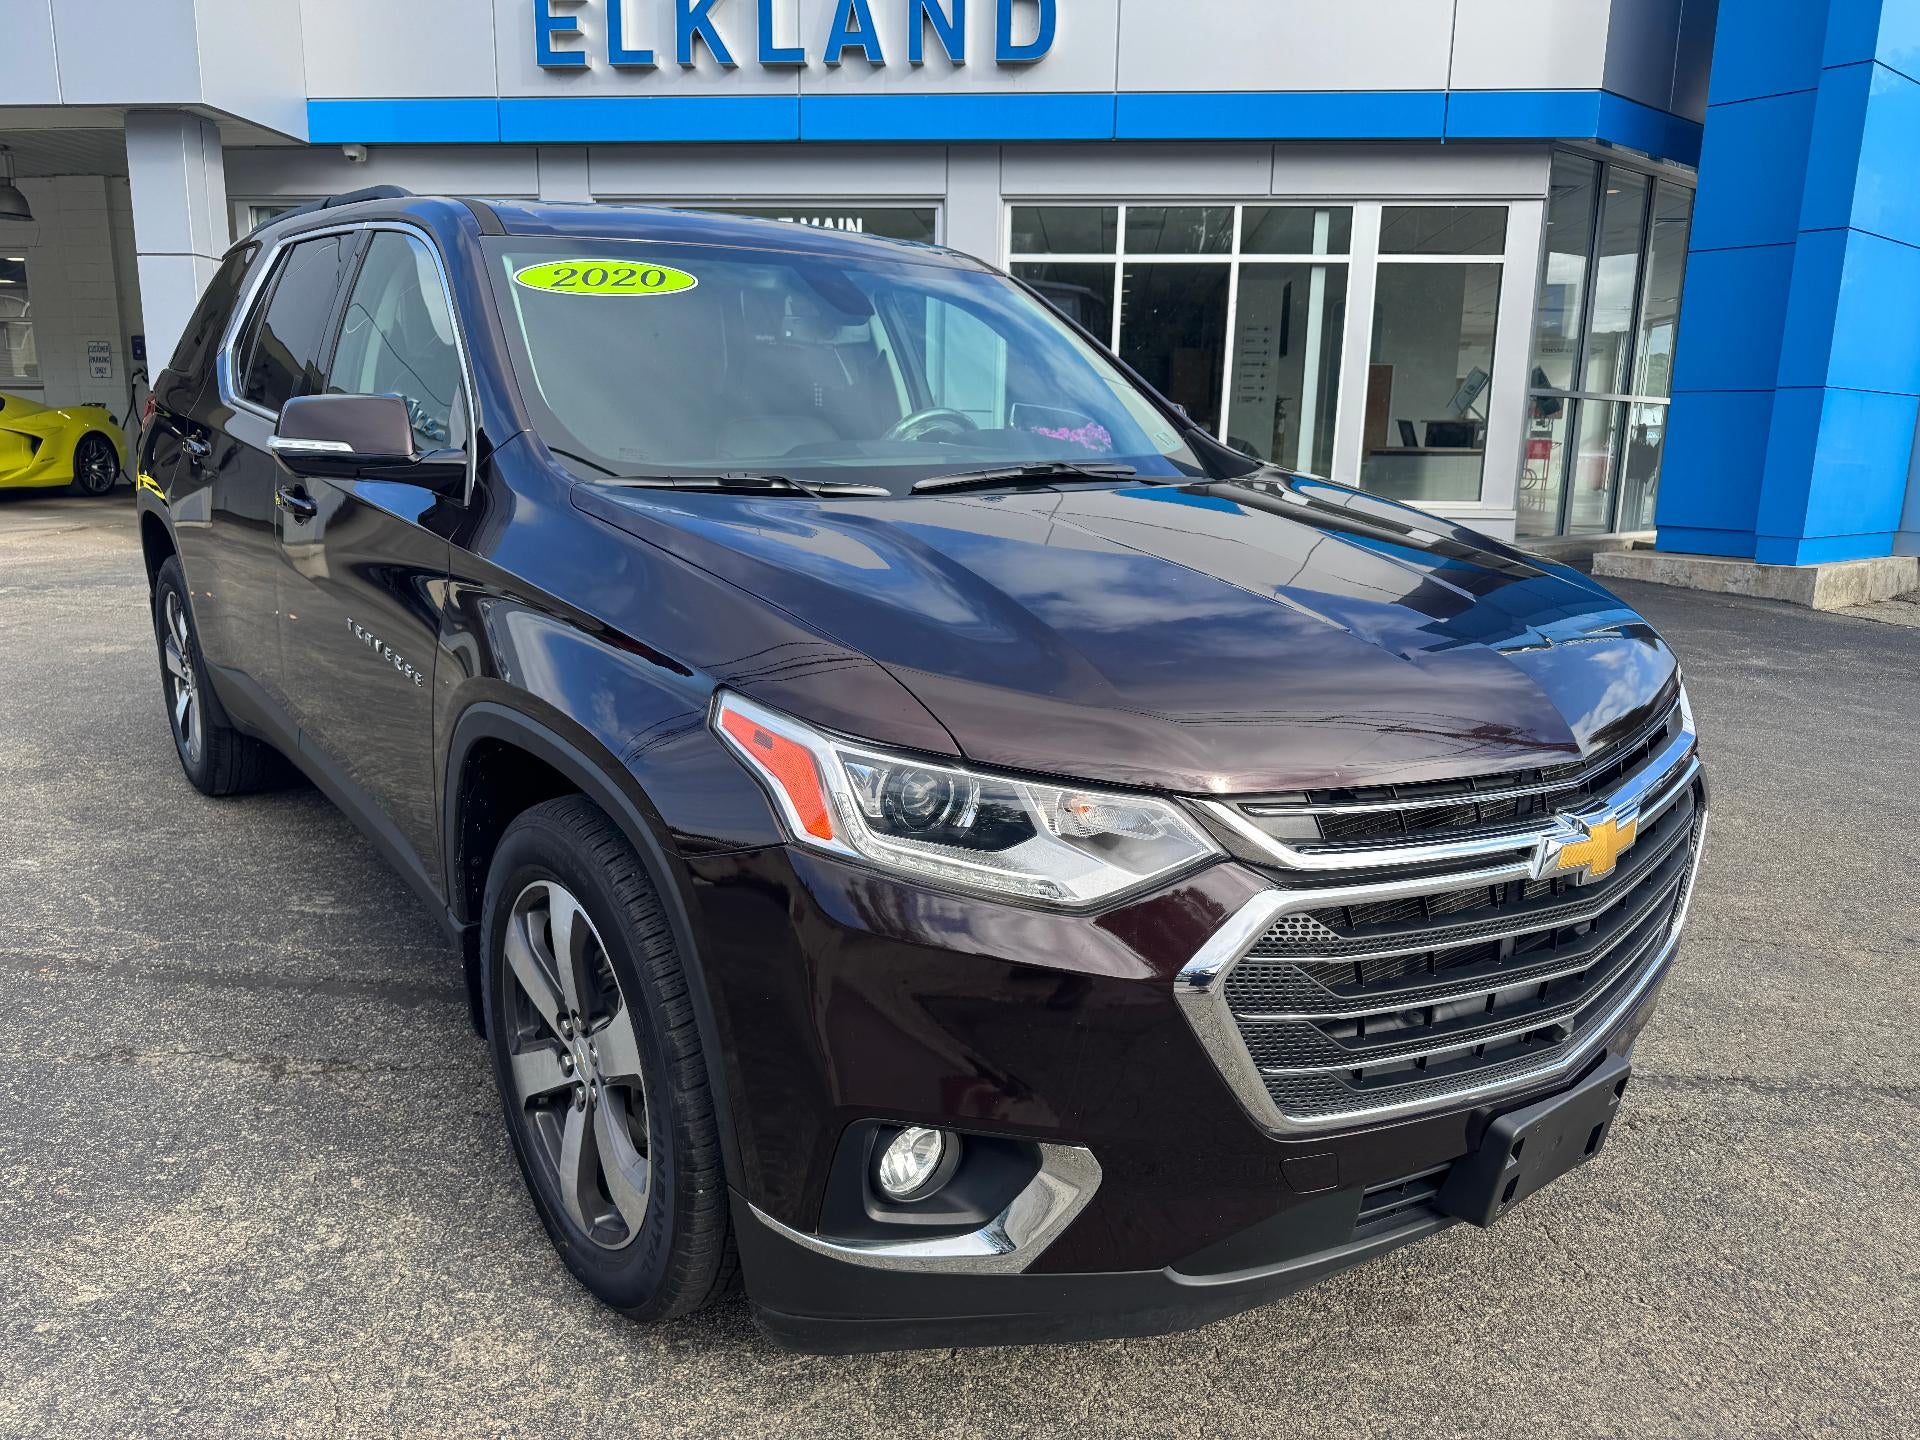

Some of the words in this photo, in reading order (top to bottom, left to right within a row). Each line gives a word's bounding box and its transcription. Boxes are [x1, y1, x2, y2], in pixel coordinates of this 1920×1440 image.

[534, 0, 1056, 67] ELKLAND
[550, 267, 667, 288] 2020
[346, 617, 424, 687] TRAVERSE
